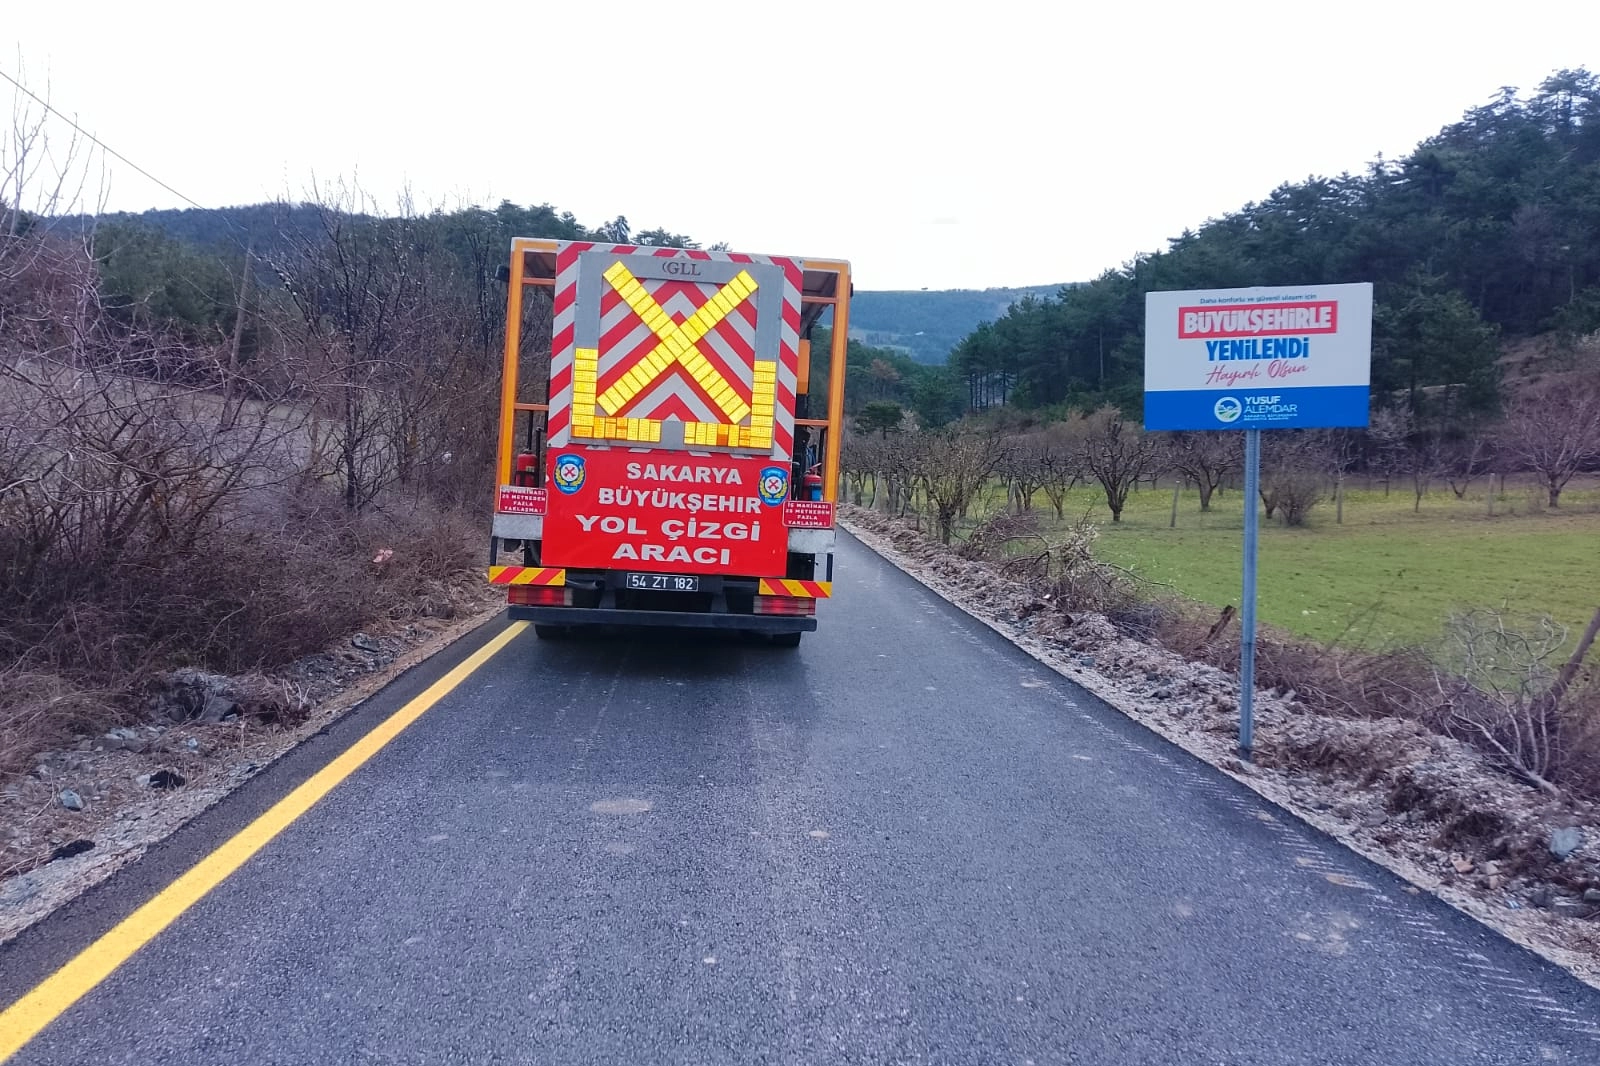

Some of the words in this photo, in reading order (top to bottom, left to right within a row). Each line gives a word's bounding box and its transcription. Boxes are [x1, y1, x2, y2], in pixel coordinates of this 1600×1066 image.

[1183, 306, 1332, 334] BÜYÜKŞEHİRLE
[1267, 359, 1308, 378] Olsun
[1243, 404, 1298, 414] ALEMDAR
[1244, 395, 1281, 405] YUSUF
[626, 462, 743, 485] SAKARYA
[575, 514, 647, 535] YOL
[661, 517, 761, 541] ÇİZGİ
[612, 543, 730, 565] ARACI
[632, 575, 646, 587] 54
[652, 576, 669, 588] ZT
[674, 577, 693, 590] 182
